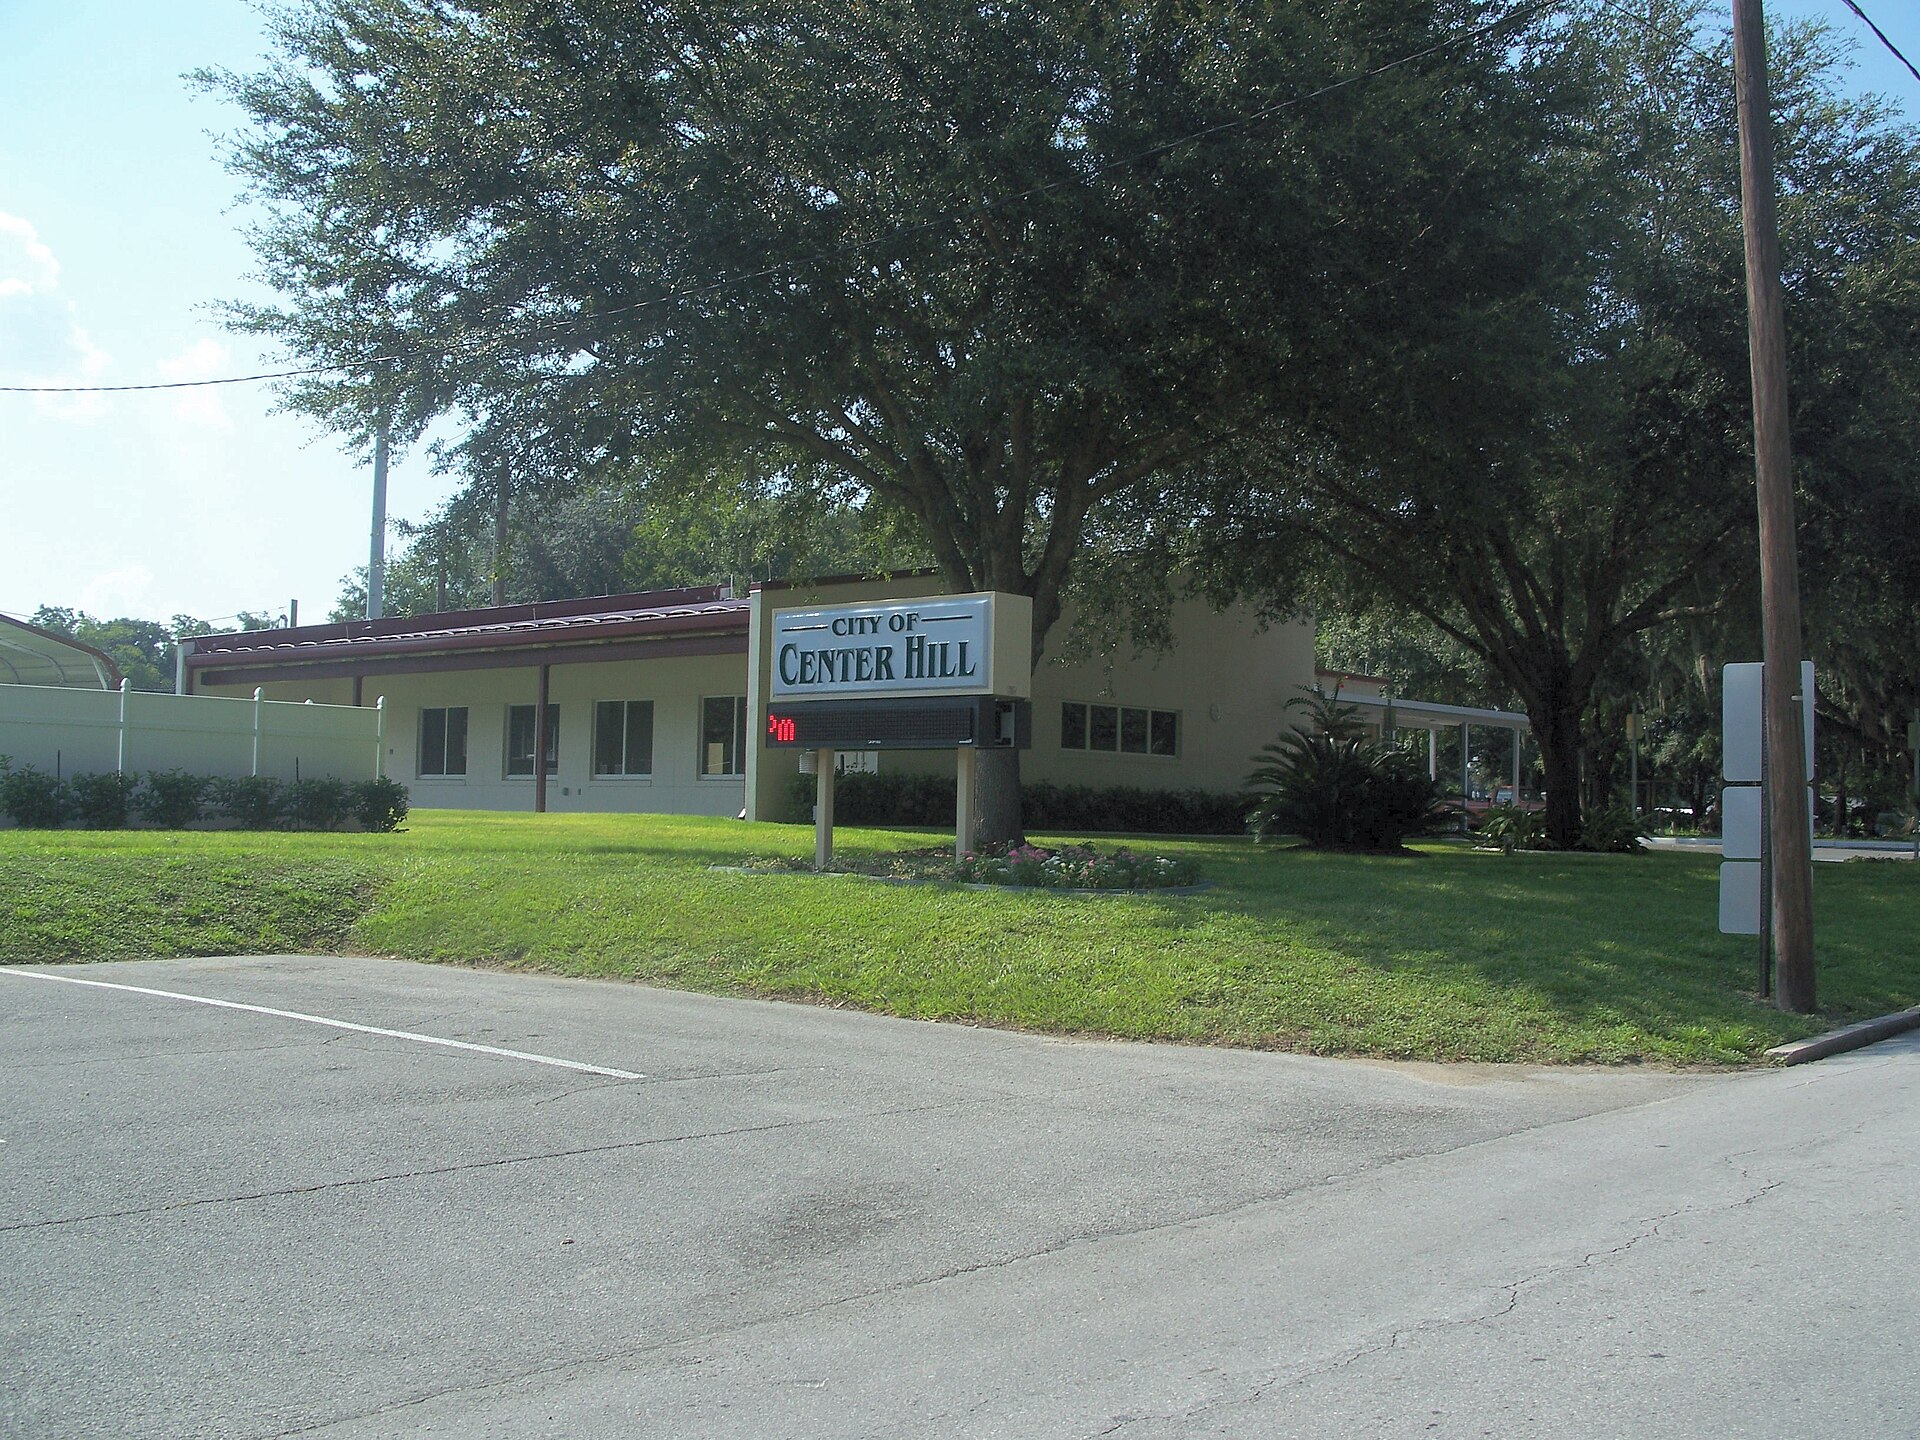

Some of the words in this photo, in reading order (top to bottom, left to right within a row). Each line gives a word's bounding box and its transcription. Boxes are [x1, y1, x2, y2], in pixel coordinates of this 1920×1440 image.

[831, 615, 883, 636] CITY
[888, 612, 920, 633] OF
[779, 643, 895, 686] CENTER
[904, 634, 976, 679] HILL
